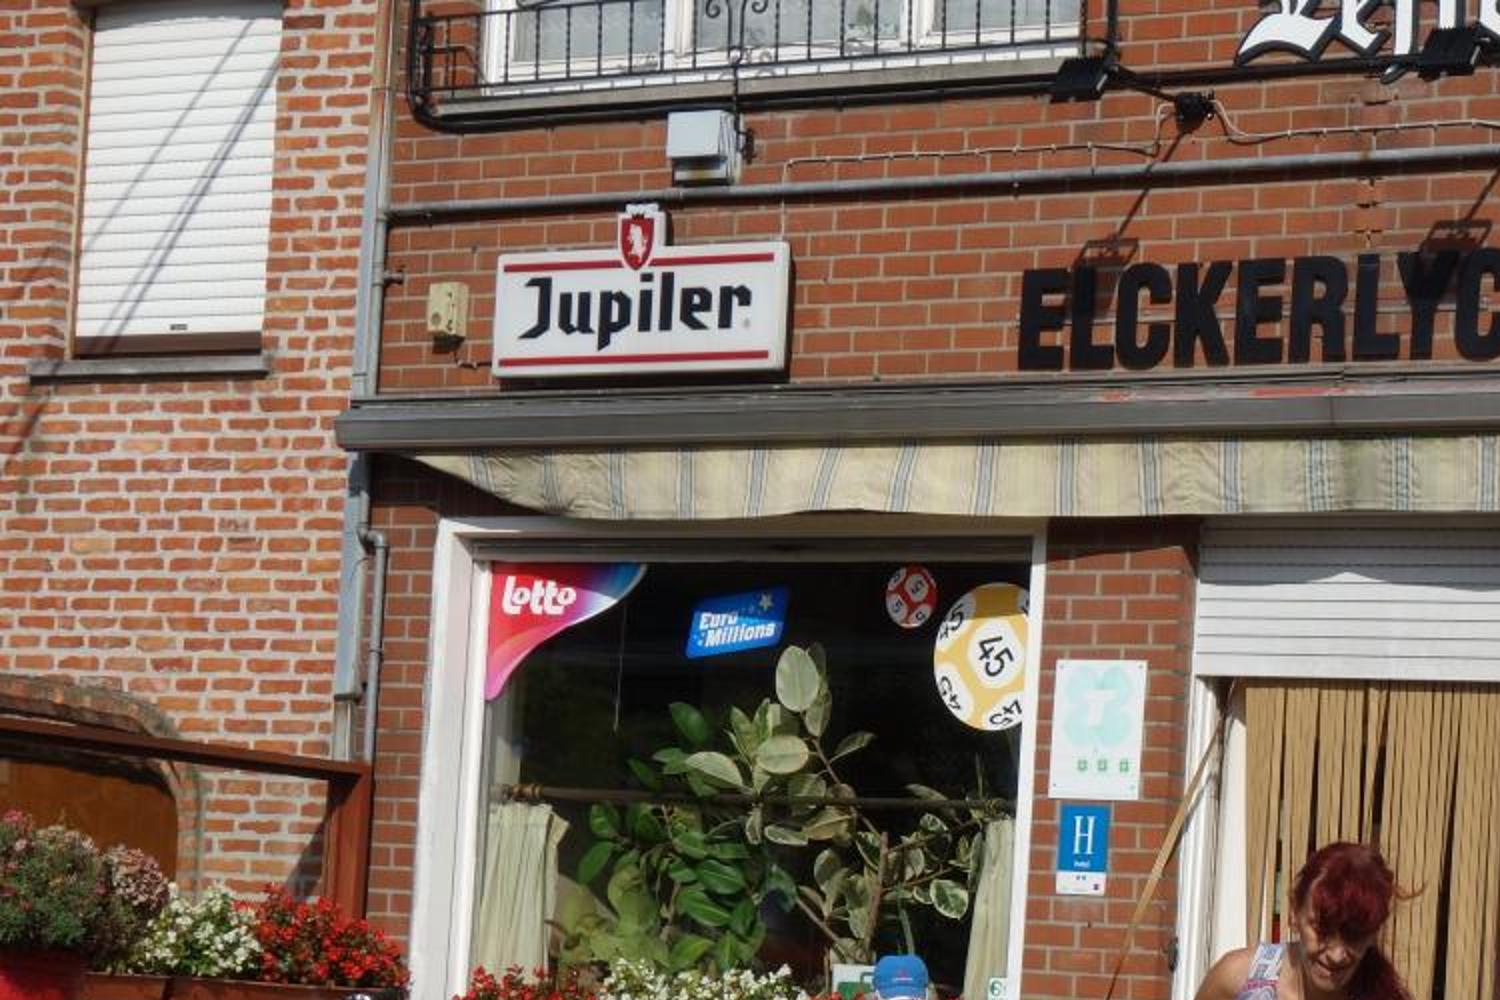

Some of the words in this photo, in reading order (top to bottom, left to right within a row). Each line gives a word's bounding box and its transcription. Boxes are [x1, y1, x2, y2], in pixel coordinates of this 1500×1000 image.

[518, 272, 752, 350] Jupiler
[502, 575, 577, 616] lotto
[699, 610, 738, 630] Euro
[704, 622, 776, 647] Millions
[978, 635, 1015, 677] 45
[1073, 815, 1096, 855] H
